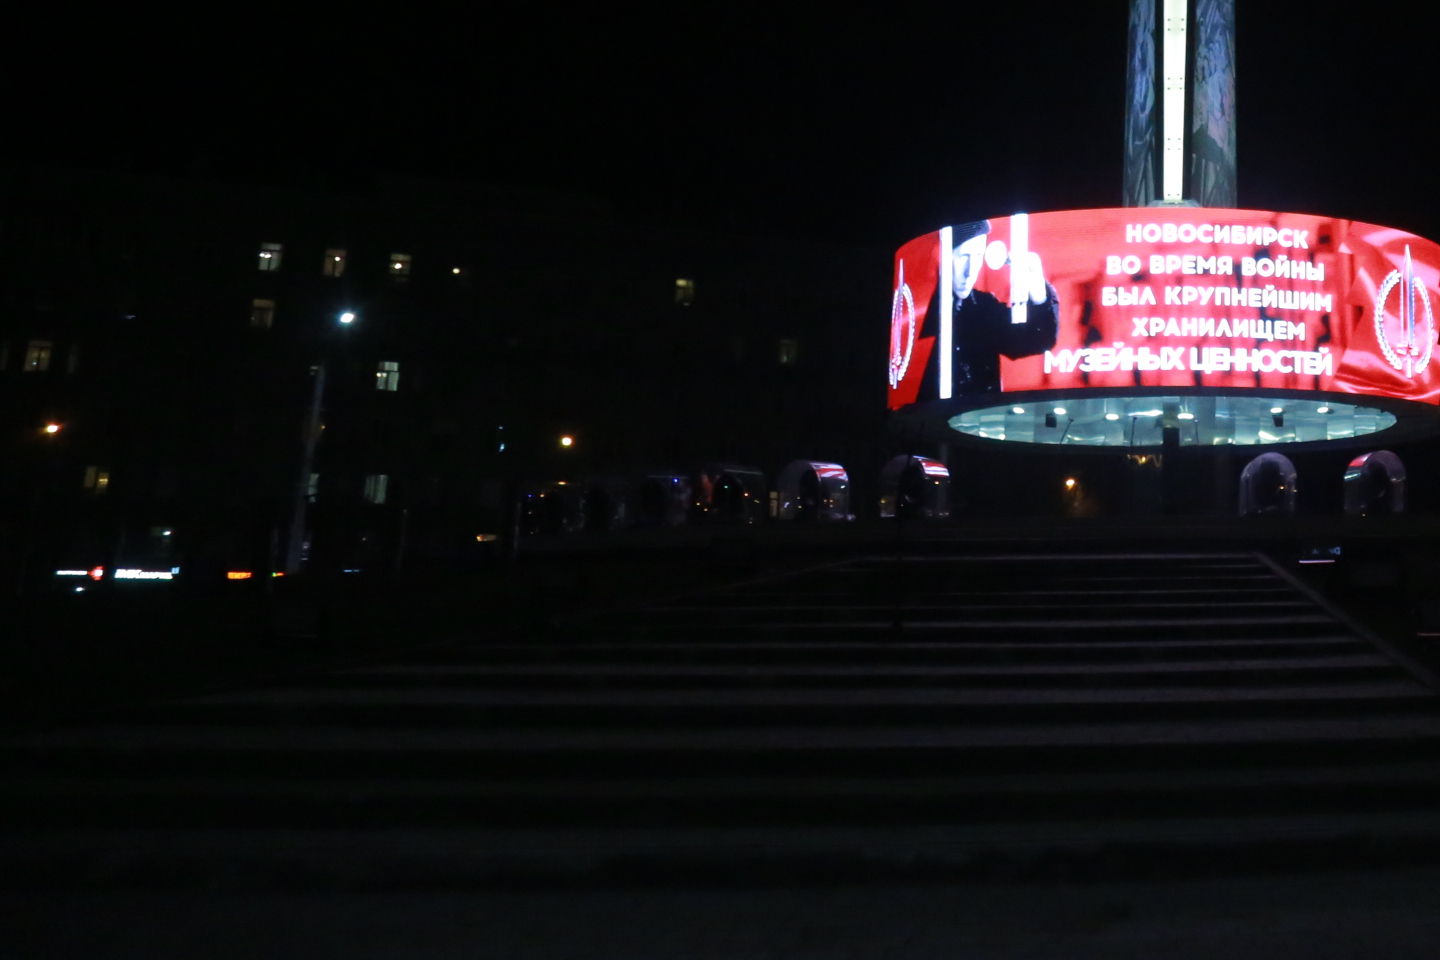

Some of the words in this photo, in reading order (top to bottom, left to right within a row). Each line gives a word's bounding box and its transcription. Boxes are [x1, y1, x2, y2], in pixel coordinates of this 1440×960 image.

[1126, 223, 1308, 249] НОВОСИБИРСК
[1106, 255, 1142, 275] ВО
[1149, 254, 1233, 275] ВРЕМЯ
[1241, 254, 1325, 281] ВОЙНЫ
[1101, 286, 1157, 306] БЫЛ
[1164, 284, 1332, 312] КРУПНЕЙШИМ
[1131, 317, 1305, 342] ХРАНИЛИЩЕМ
[1044, 342, 1186, 374] МУЗЕЙНЫХ
[1189, 346, 1333, 376] ЦЕННОСТЕЙ
